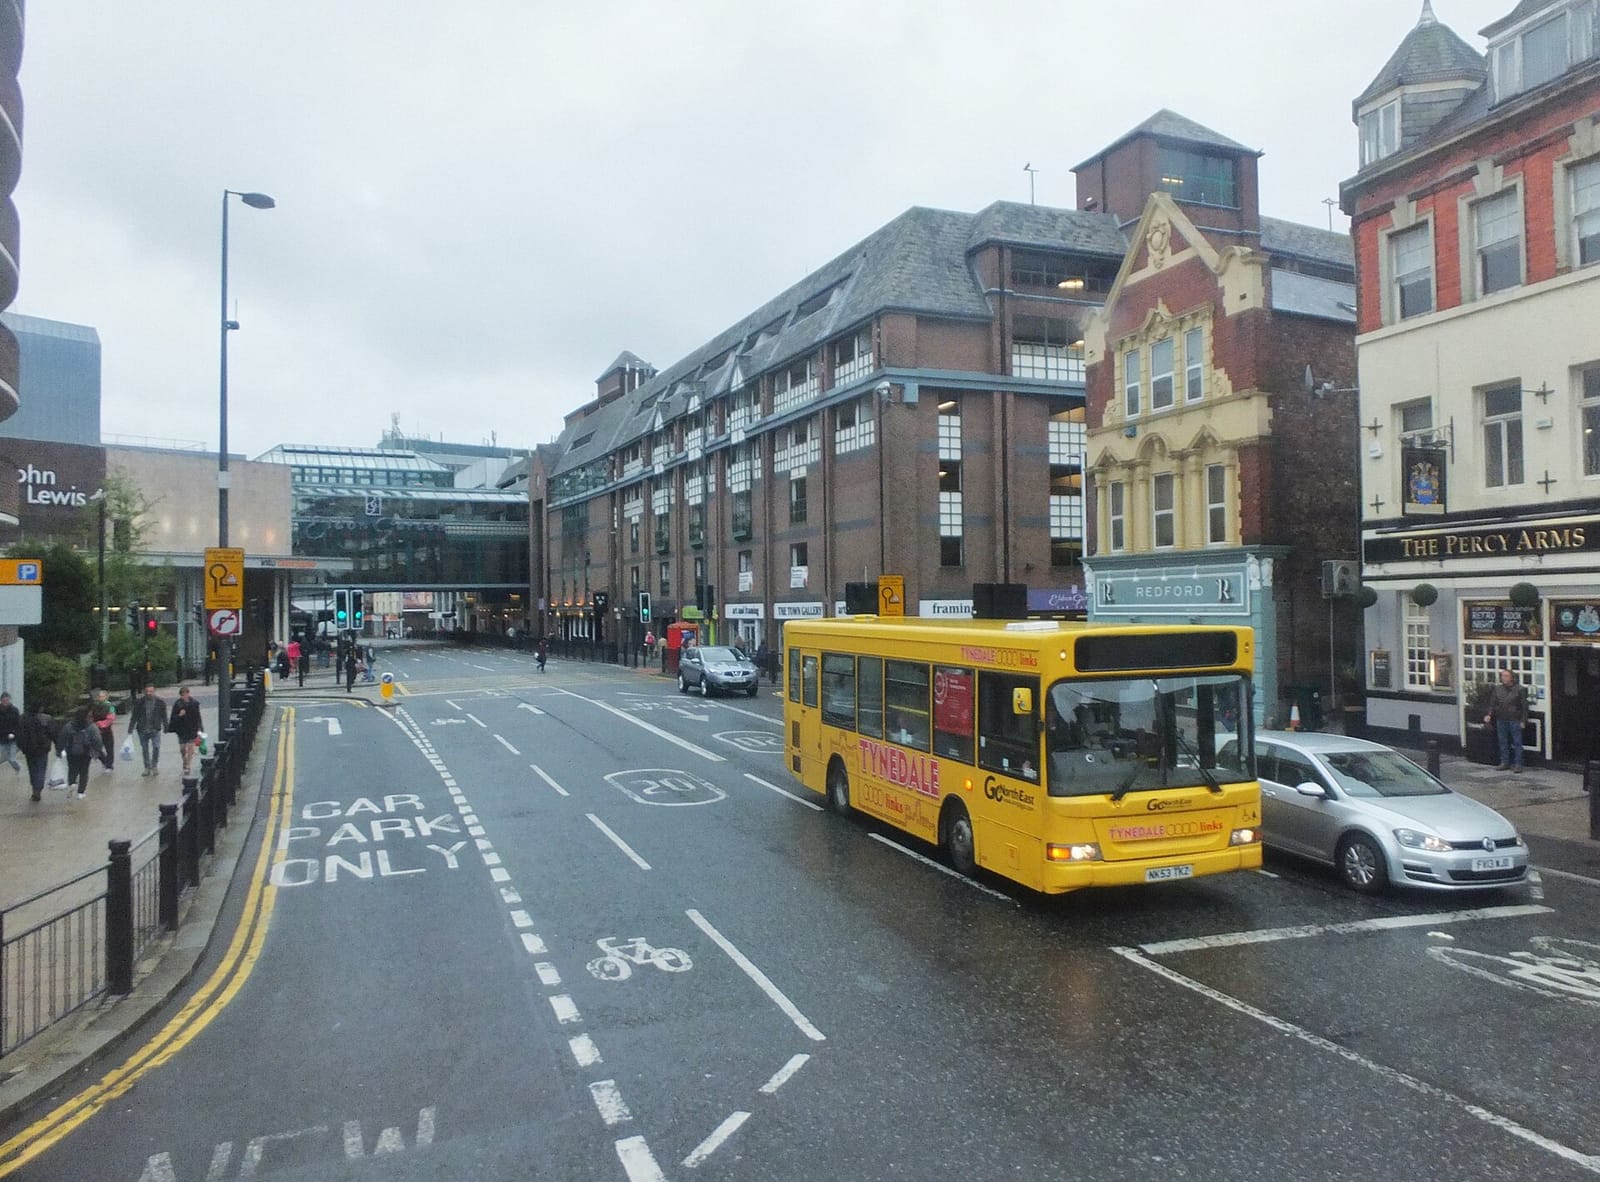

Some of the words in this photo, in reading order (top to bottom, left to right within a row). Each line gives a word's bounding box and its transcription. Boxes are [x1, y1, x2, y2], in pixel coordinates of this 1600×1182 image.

[17, 463, 56, 485] ohn
[27, 484, 87, 506] Lewis
[1401, 538, 1439, 557] THE
[1445, 533, 1511, 554] PERCY
[1517, 527, 1586, 551] ARMS
[22, 565, 35, 579] P
[1136, 585, 1204, 598] REDFORD
[777, 607, 787, 616] THE
[787, 606, 800, 616] TOWN
[801, 605, 822, 616] GALLERY
[932, 602, 973, 614] framin
[961, 645, 995, 662] TYNEDALE
[1019, 652, 1038, 667] links
[859, 738, 940, 799] TYNEDALE
[632, 776, 697, 795] 20
[302, 793, 425, 820] CAR
[885, 792, 904, 814] links
[277, 813, 461, 852] PARK
[1108, 825, 1165, 840] TYNEDALE
[1200, 821, 1224, 833] links
[269, 841, 468, 887] ONLY
[1148, 869, 1171, 880] NK53
